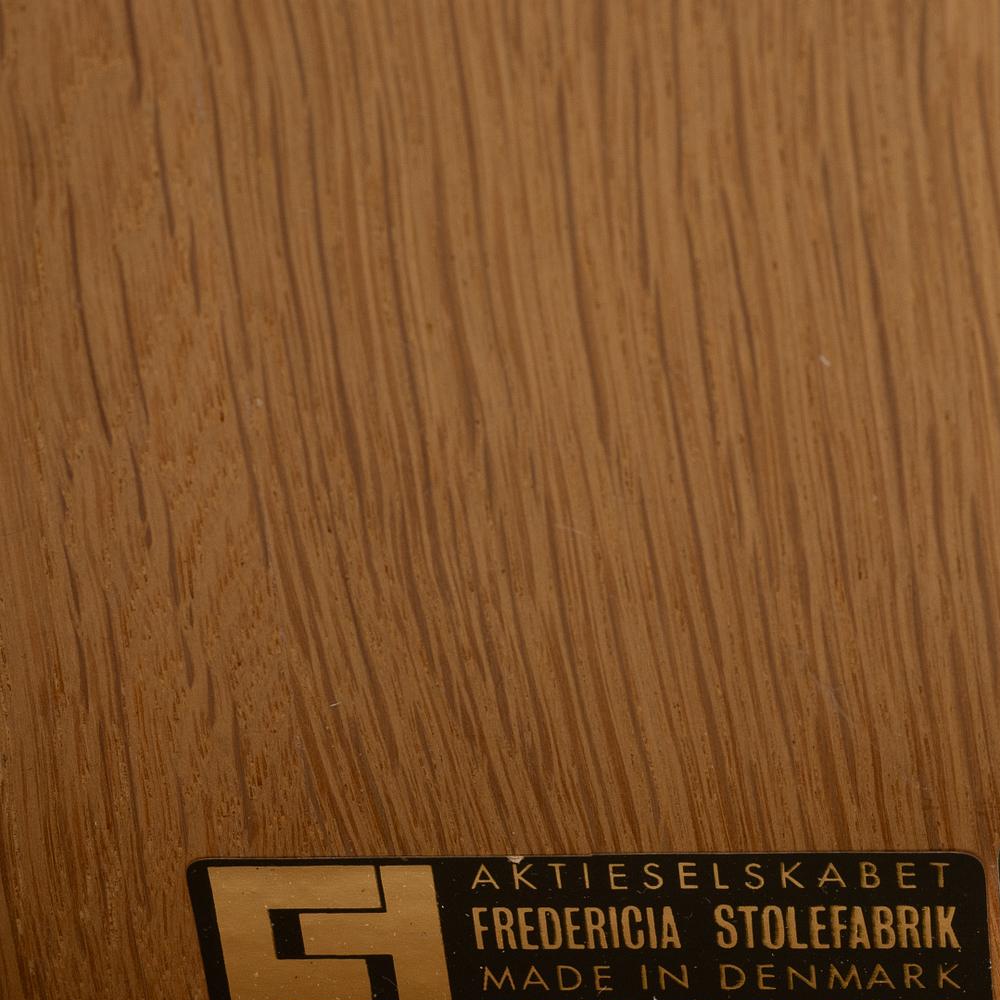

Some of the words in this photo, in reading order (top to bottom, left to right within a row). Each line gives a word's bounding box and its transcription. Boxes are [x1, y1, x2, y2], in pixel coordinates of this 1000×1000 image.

[471, 861, 950, 890] AKTIESELSKABET
[471, 905, 682, 950] FREDERICIA
[713, 904, 961, 950] STOLEFABRIK
[482, 964, 614, 991] MADE
[640, 964, 689, 991] IN
[718, 963, 962, 991] DENMARK
